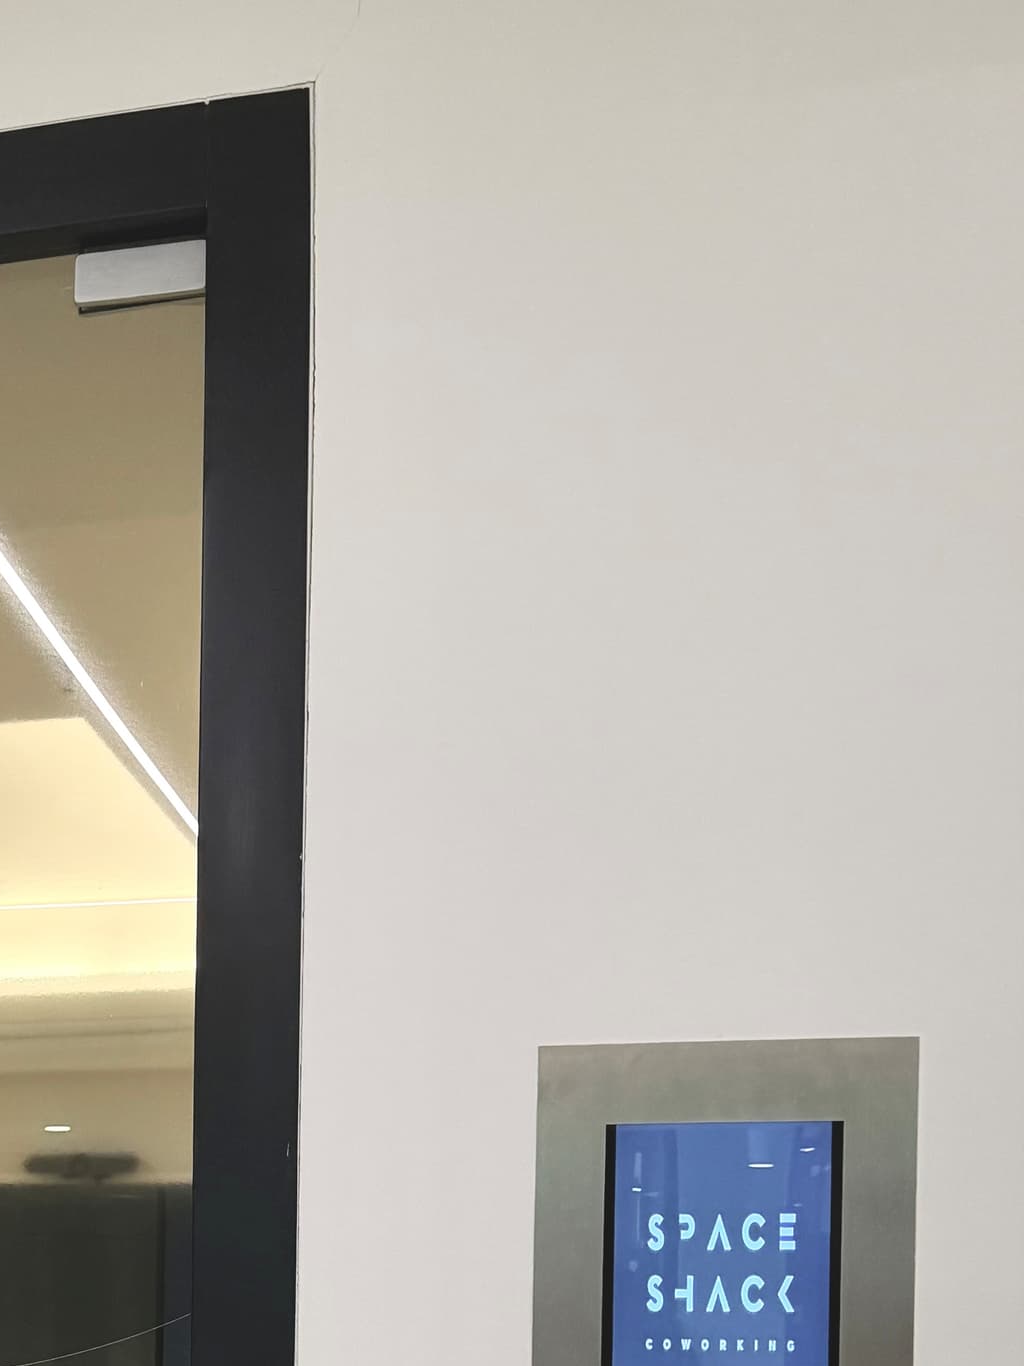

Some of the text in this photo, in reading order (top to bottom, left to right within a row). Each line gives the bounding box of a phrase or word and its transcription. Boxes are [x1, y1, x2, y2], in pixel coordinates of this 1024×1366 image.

[647, 1213, 797, 1251] SPACE
[646, 1275, 795, 1313] SHACK
[645, 1338, 796, 1352] COWORKING
